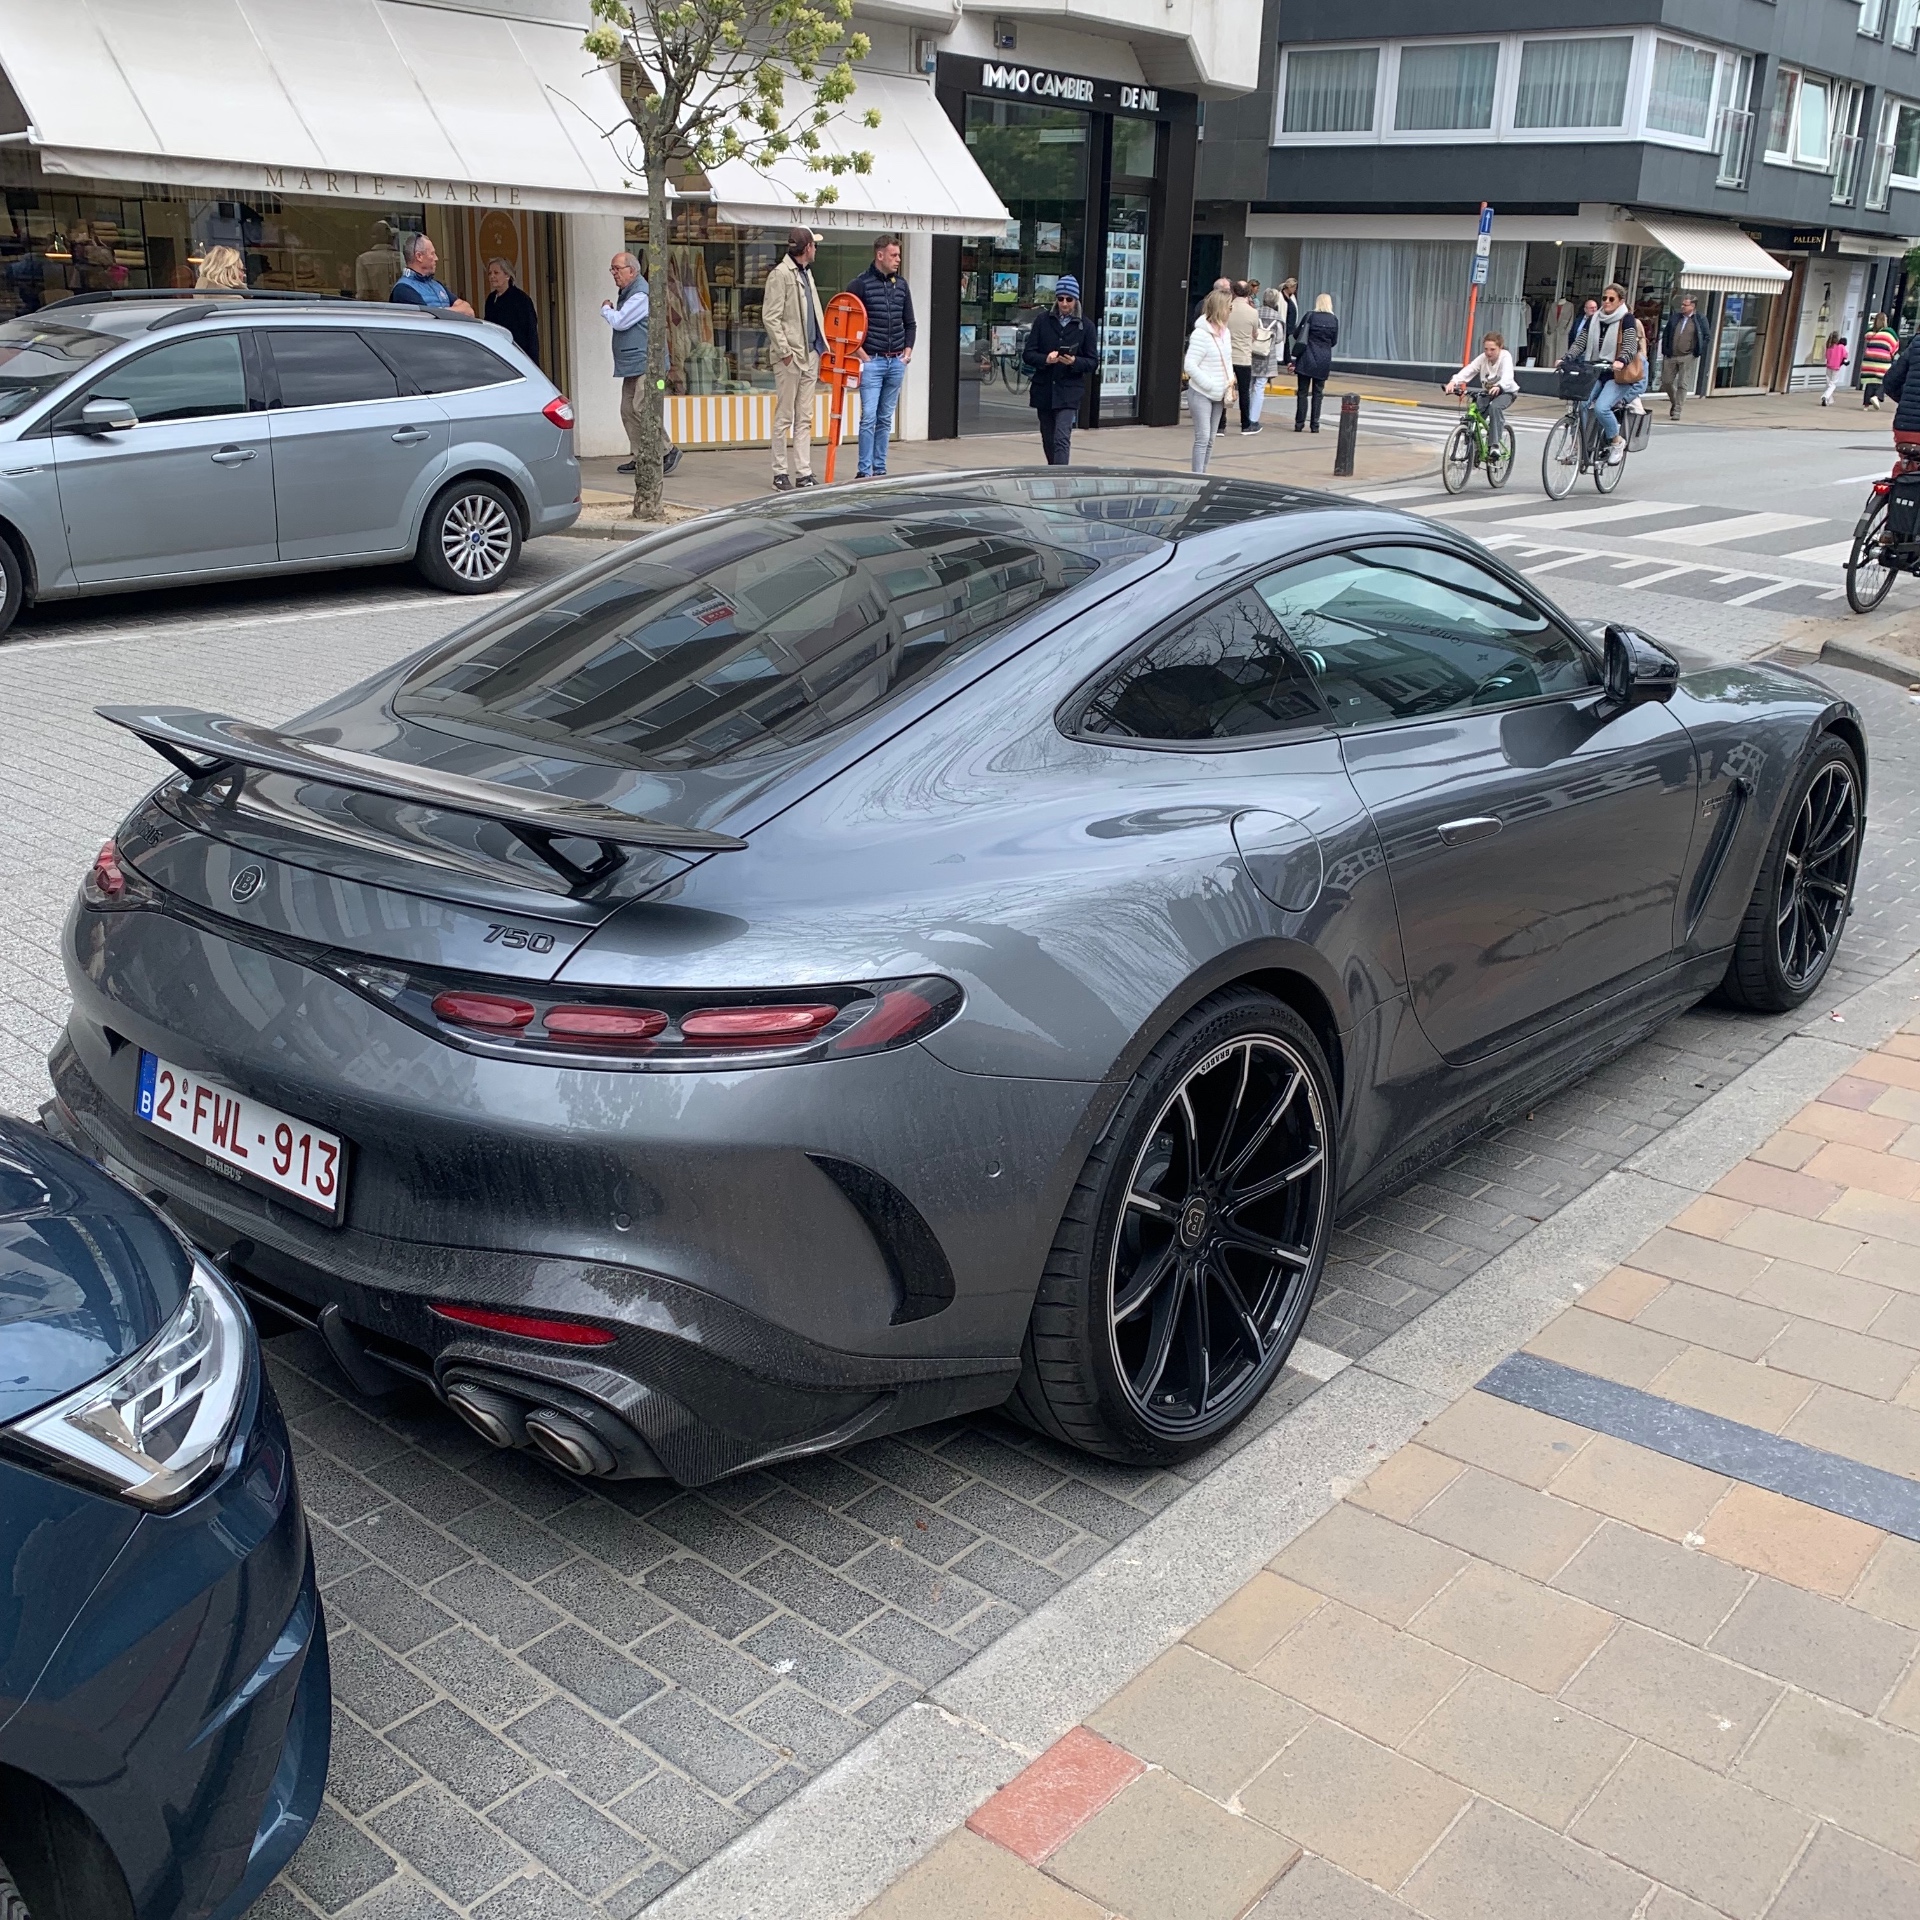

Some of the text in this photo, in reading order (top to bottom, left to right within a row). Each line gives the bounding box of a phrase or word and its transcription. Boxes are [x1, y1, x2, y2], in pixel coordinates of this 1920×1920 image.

[982, 63, 1030, 93] IMMO
[1031, 71, 1094, 102] CAMBIER
[1120, 86, 1140, 110] DE
[263, 166, 522, 206] MARIE-MARIE
[789, 207, 951, 232] MARIE-MARIE
[1793, 235, 1822, 244] PALLEN
[483, 923, 556, 955] 750
[1201, 1048, 1231, 1074] BRABUS
[140, 1090, 152, 1114] B
[205, 1154, 242, 1182] BRABUS
